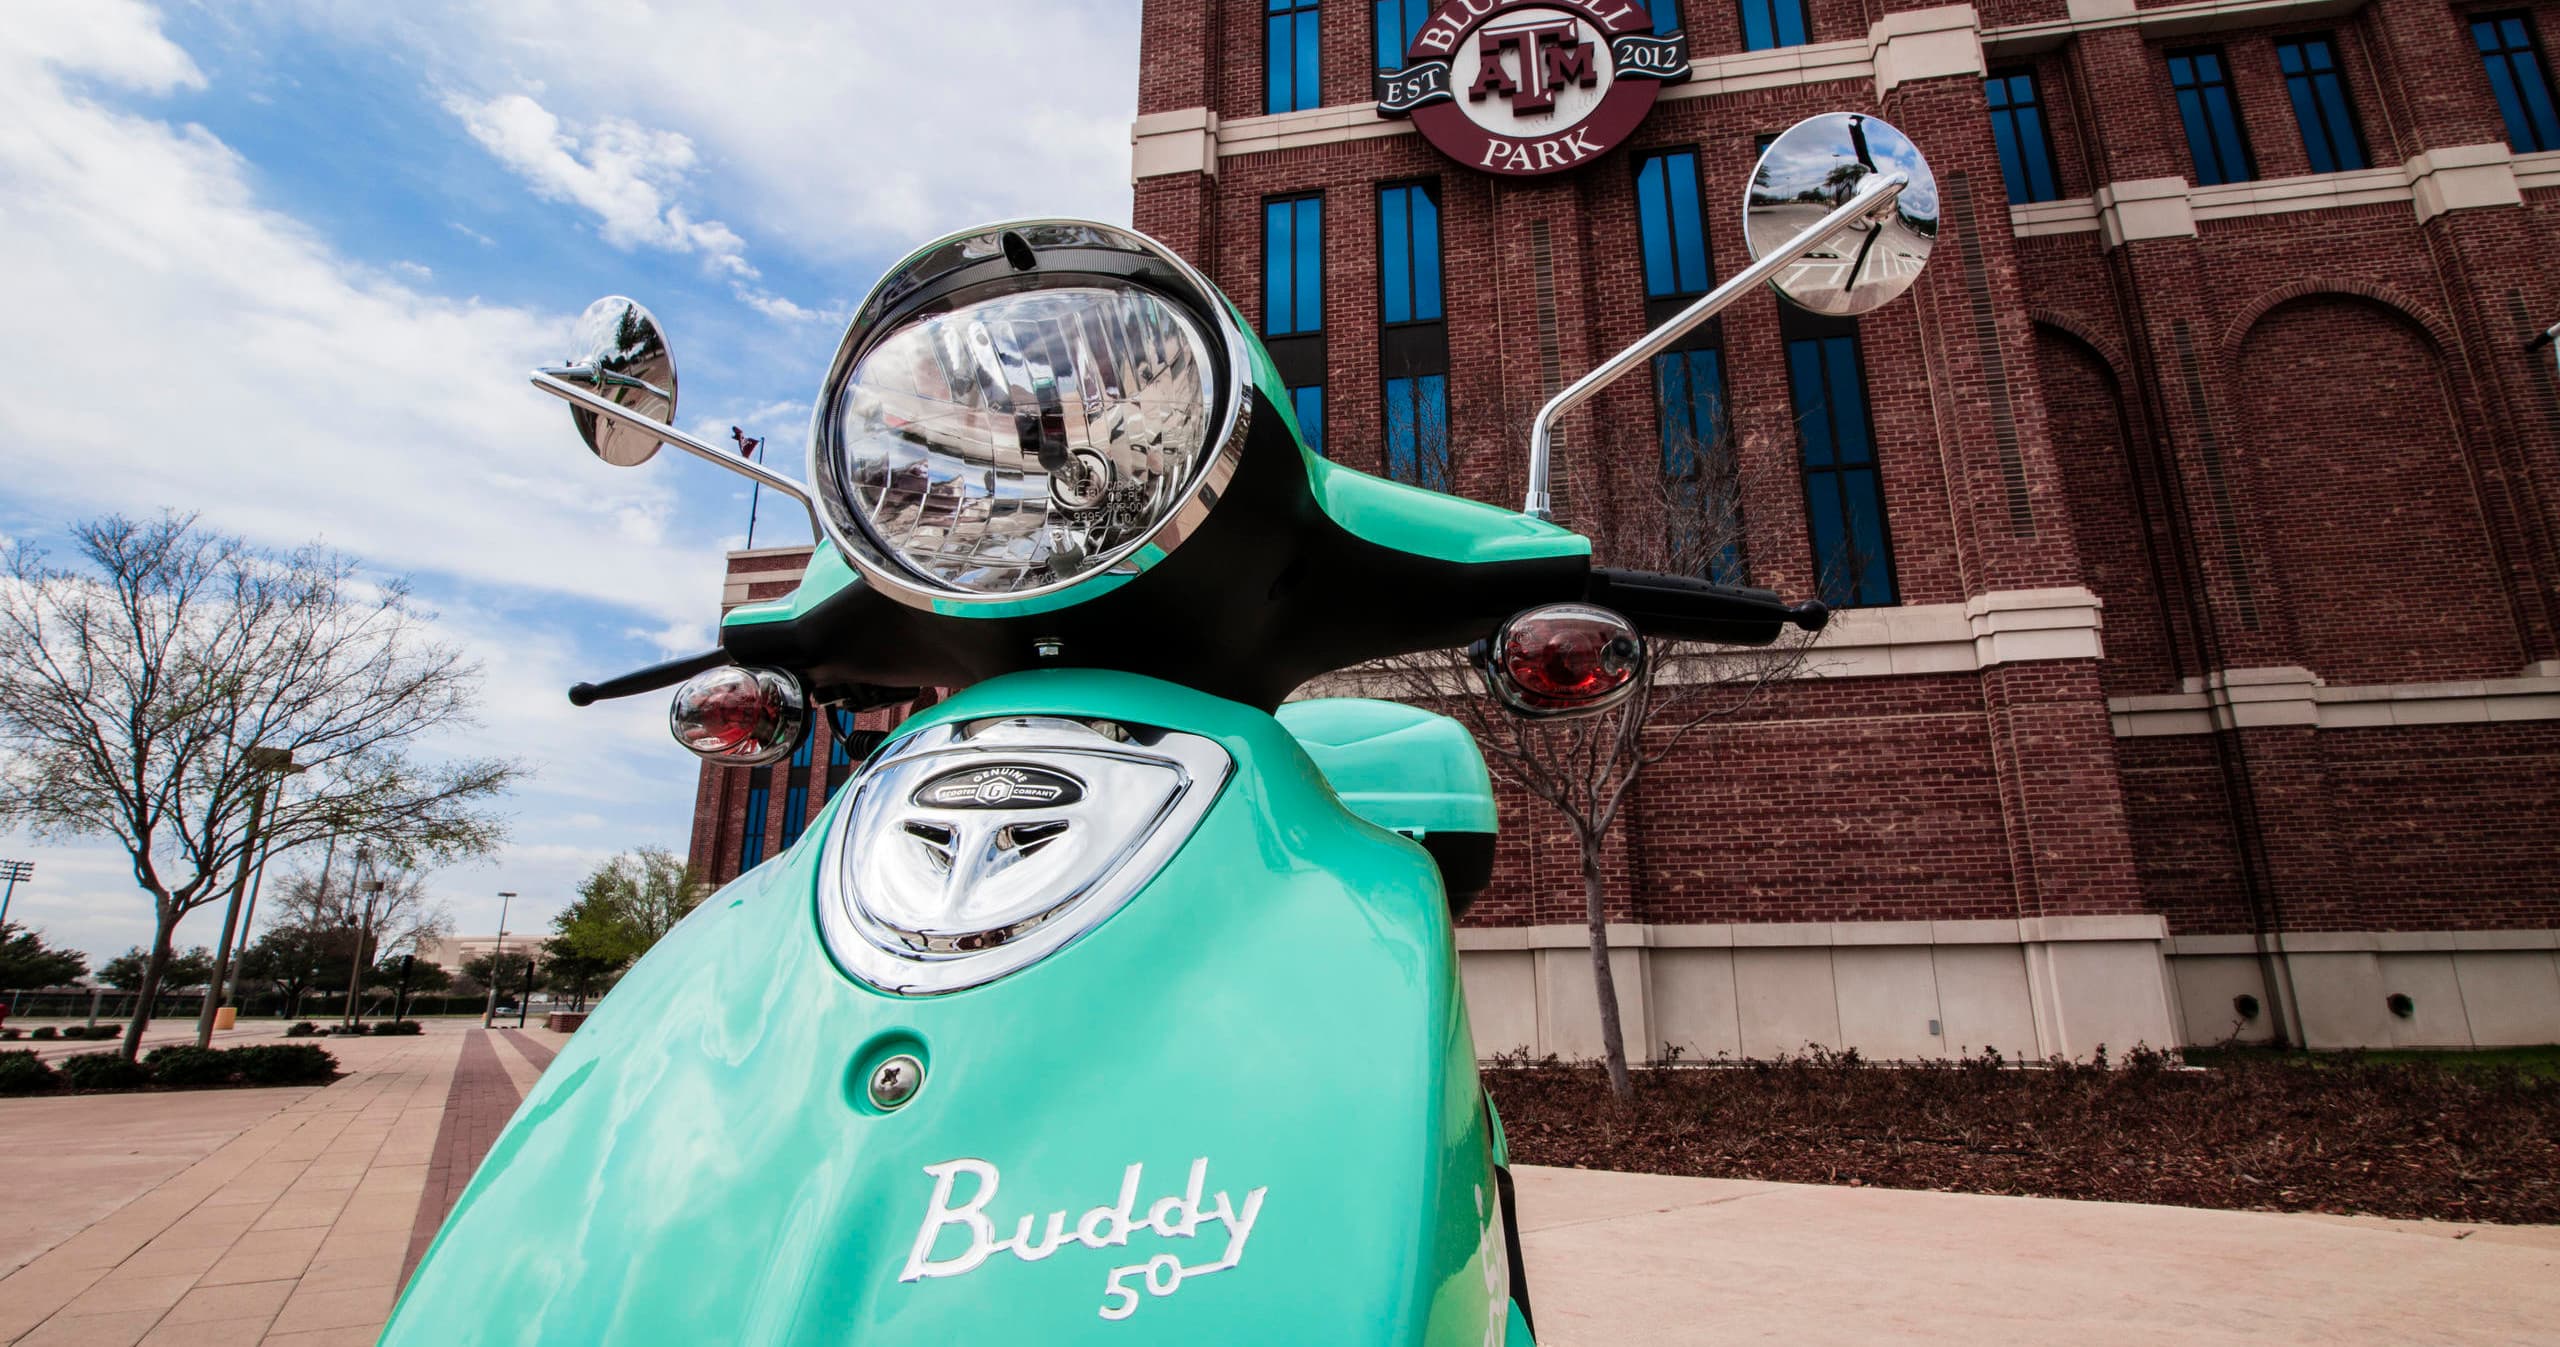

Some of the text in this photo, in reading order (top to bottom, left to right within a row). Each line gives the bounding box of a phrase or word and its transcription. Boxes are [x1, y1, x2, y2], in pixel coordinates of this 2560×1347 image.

[1420, 0, 1519, 51] BLU
[1387, 45, 1677, 102] EST 2012
[1480, 127, 1604, 170] PARK
[943, 789, 976, 797] SCOOTER
[1013, 788, 1054, 798] COMPANY
[973, 768, 1027, 783] GENUINE
[898, 1156, 1268, 1282] Buddy
[1099, 1254, 1182, 1320] 50
